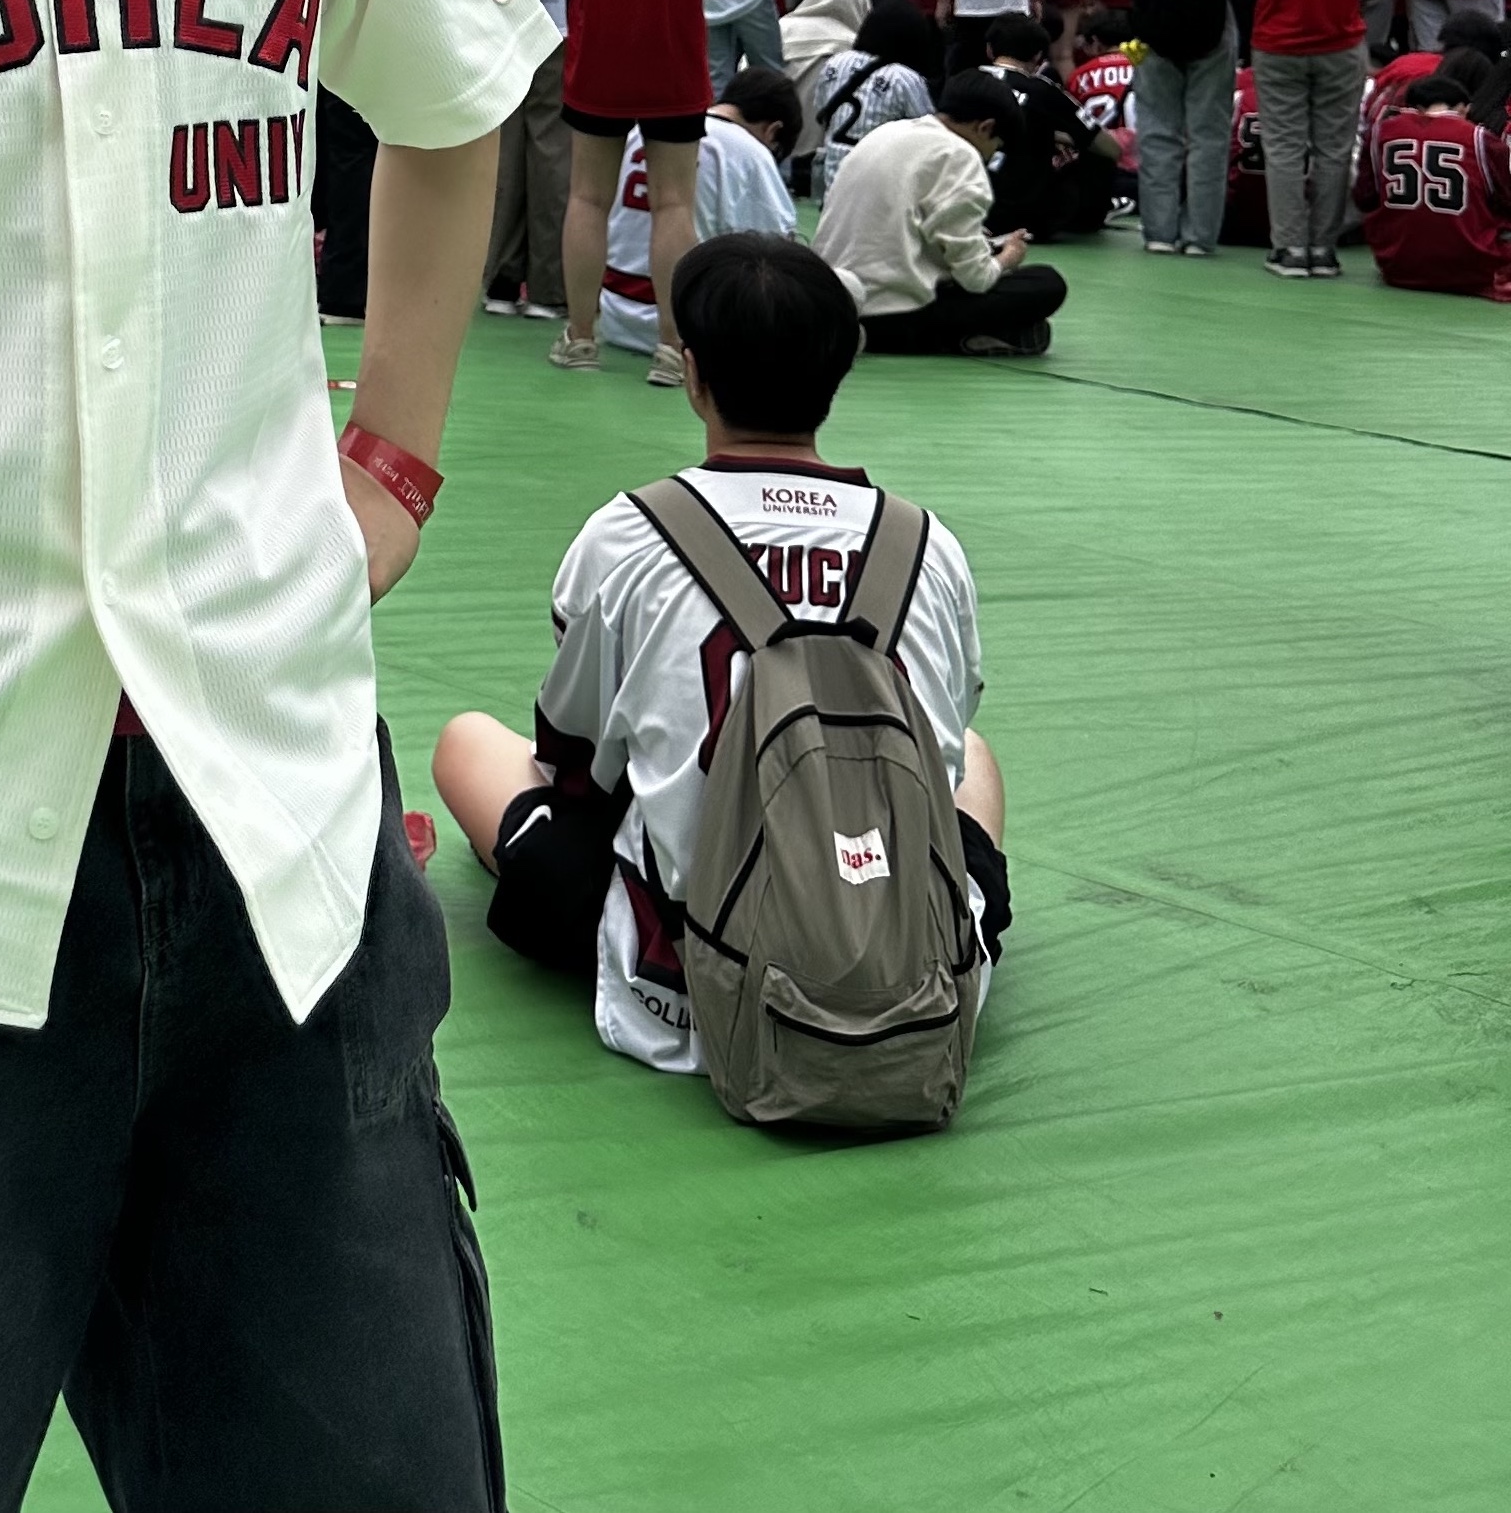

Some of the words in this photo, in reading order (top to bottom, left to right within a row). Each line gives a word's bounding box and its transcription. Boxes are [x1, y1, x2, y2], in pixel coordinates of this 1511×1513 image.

[1382, 139, 1468, 216] 55
[761, 487, 838, 507] KOREA
[762, 503, 838, 517] UNIVERSITY
[738, 542, 864, 607] UC
